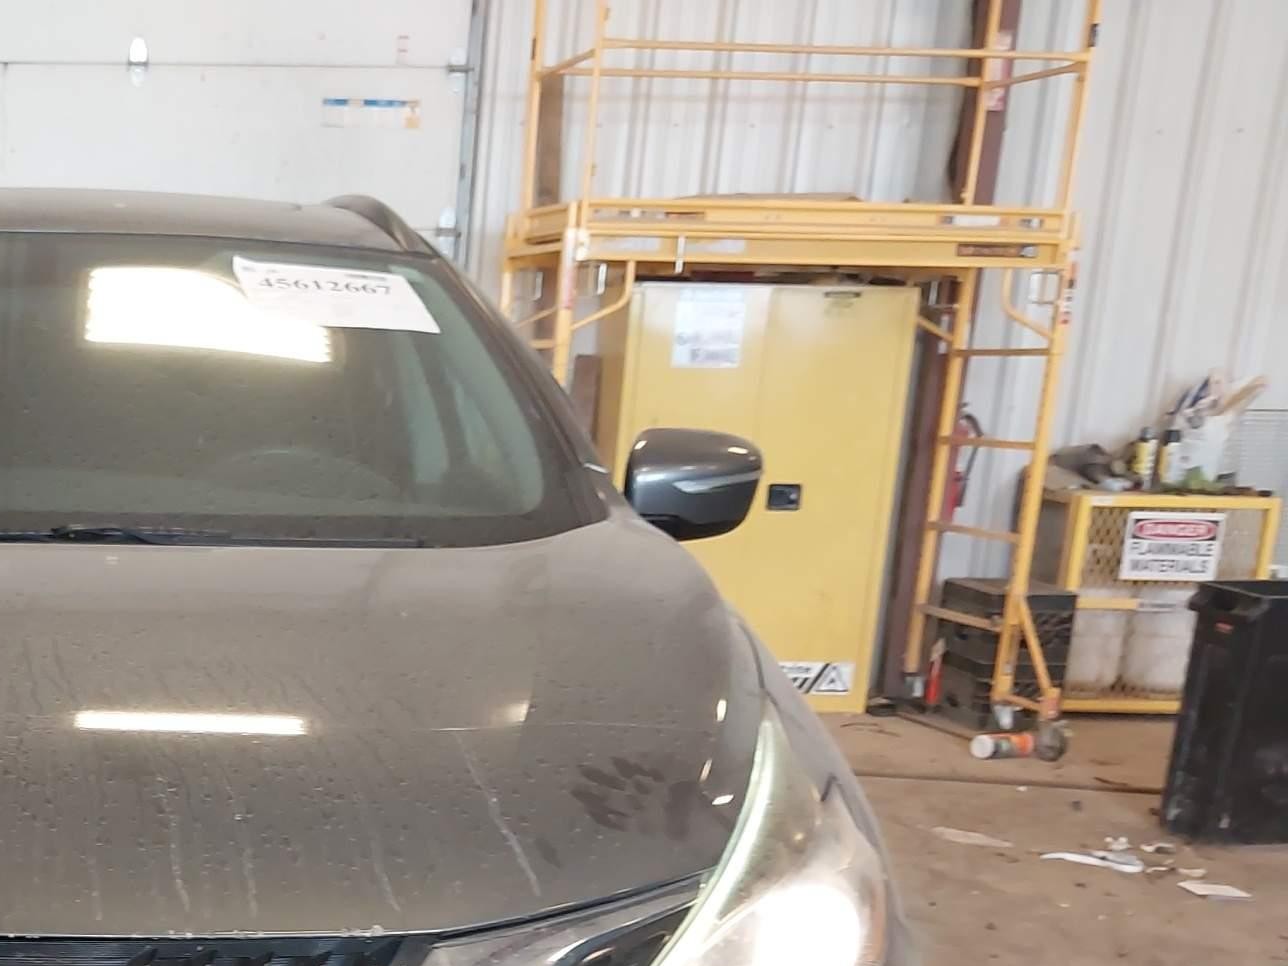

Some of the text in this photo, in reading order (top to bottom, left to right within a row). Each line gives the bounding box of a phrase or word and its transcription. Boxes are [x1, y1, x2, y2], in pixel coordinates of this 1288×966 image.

[259, 277, 392, 296] 45612667
[1141, 523, 1209, 537] DANGER
[1130, 541, 1215, 557] FLAMMABLE
[1129, 559, 1210, 574] MATERIALS
